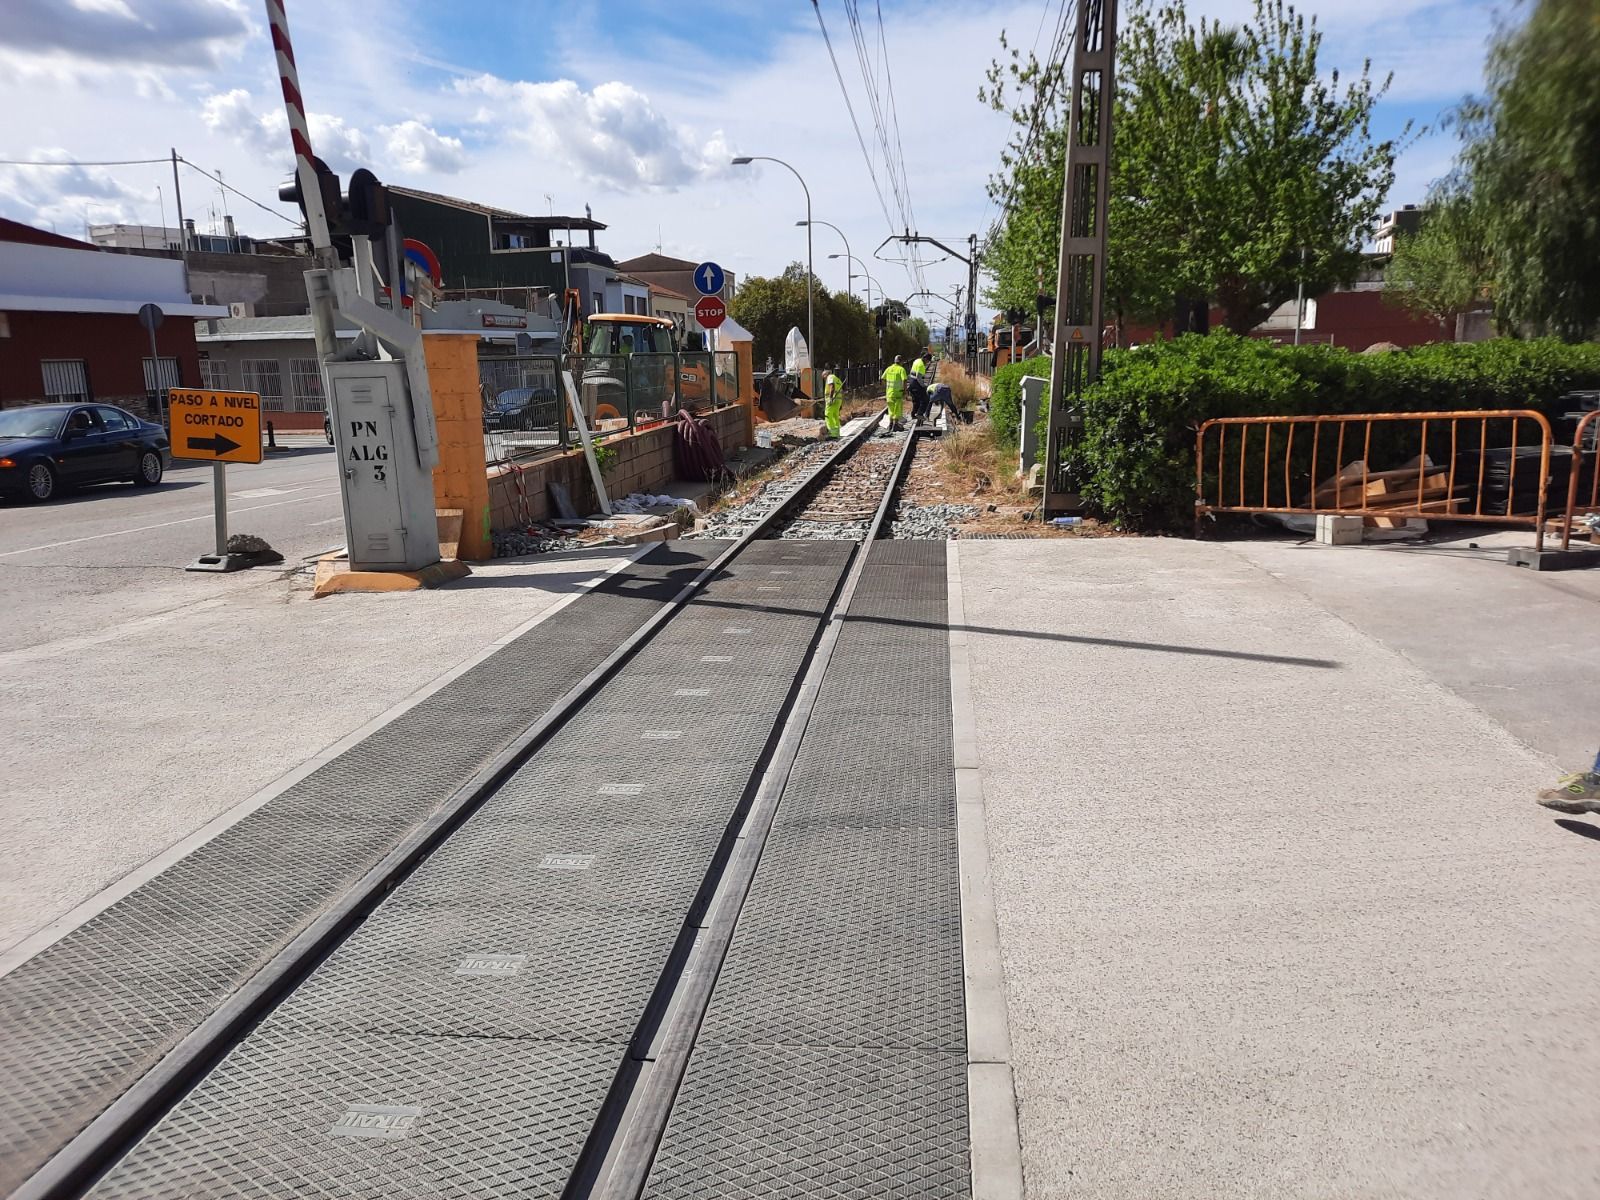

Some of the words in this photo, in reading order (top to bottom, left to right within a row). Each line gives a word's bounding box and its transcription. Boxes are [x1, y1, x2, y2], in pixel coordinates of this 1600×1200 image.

[698, 308, 723, 317] STOP
[679, 372, 697, 382] CB
[170, 393, 203, 406] PASO
[210, 395, 218, 407] A
[224, 396, 258, 409] NIVEL
[184, 413, 244, 428] CORTADO
[350, 421, 377, 437] PN
[348, 445, 388, 461] ALG
[373, 465, 386, 481] 3
[334, 1111, 417, 1130] STRAIL
